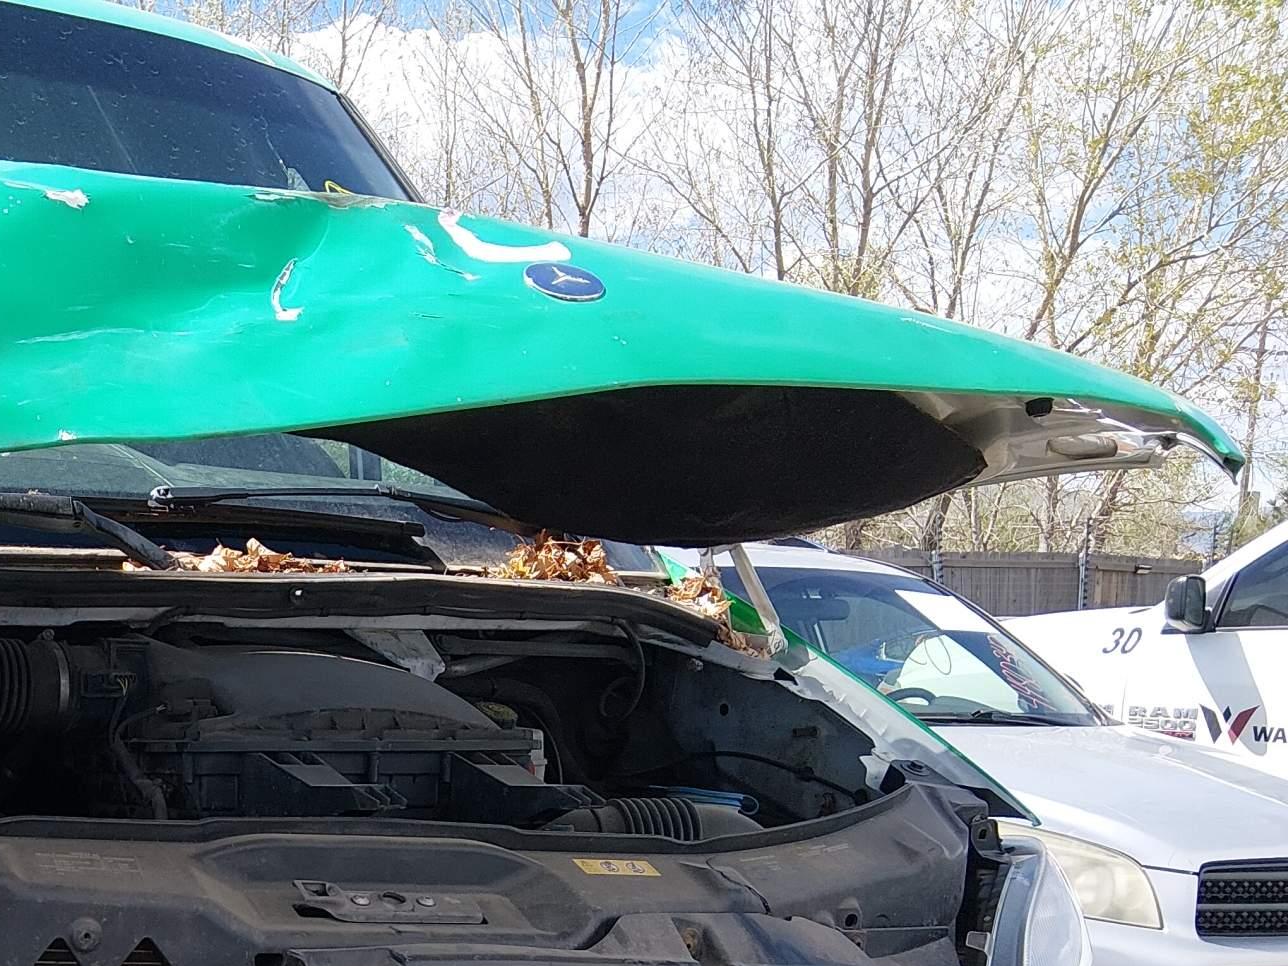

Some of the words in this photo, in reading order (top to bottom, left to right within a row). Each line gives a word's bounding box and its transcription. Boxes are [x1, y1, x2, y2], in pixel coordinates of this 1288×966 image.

[1102, 627, 1143, 654] 30
[1128, 705, 1199, 720] RAM
[1253, 726, 1287, 743] WA
